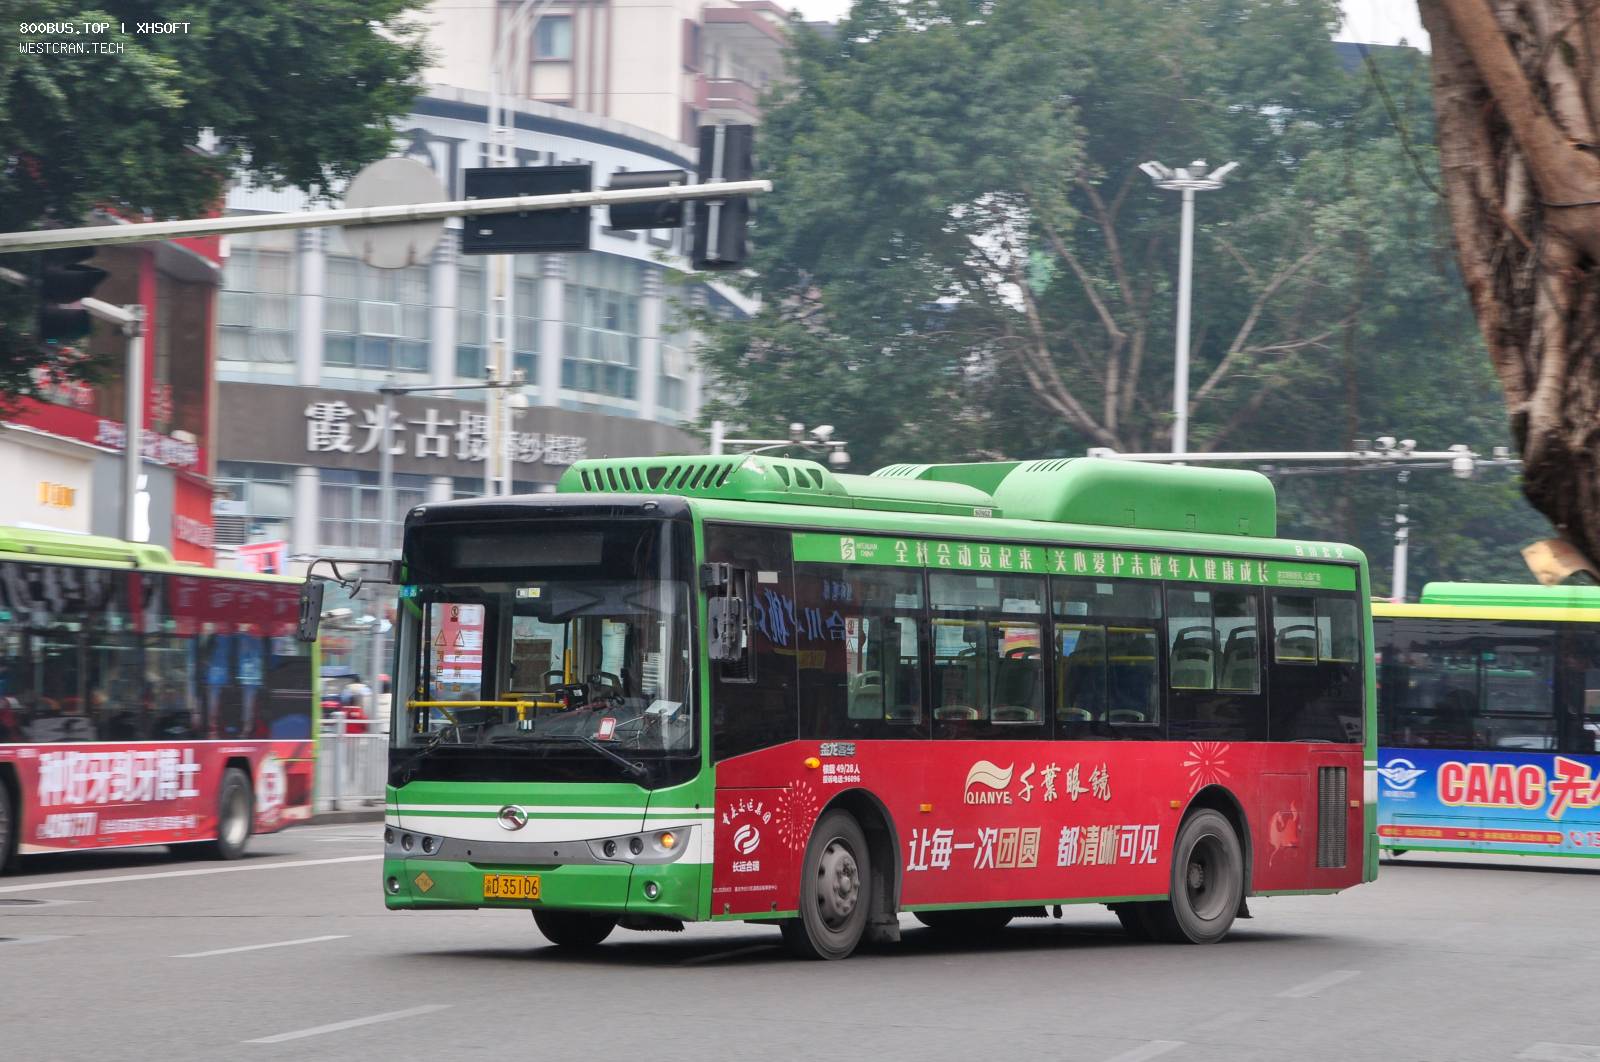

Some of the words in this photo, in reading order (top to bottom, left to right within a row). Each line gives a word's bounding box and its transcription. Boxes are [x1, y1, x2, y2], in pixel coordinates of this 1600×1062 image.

[895, 540, 1033, 571] 全社会动员起来
[1054, 549, 1269, 583] 关心爱护未成年人健康成长
[966, 791, 1011, 804] QIANYE
[1438, 761, 1546, 809] CAAC
[906, 826, 1041, 872] 让每一次团圆
[1056, 824, 1160, 867] 都清晰可见
